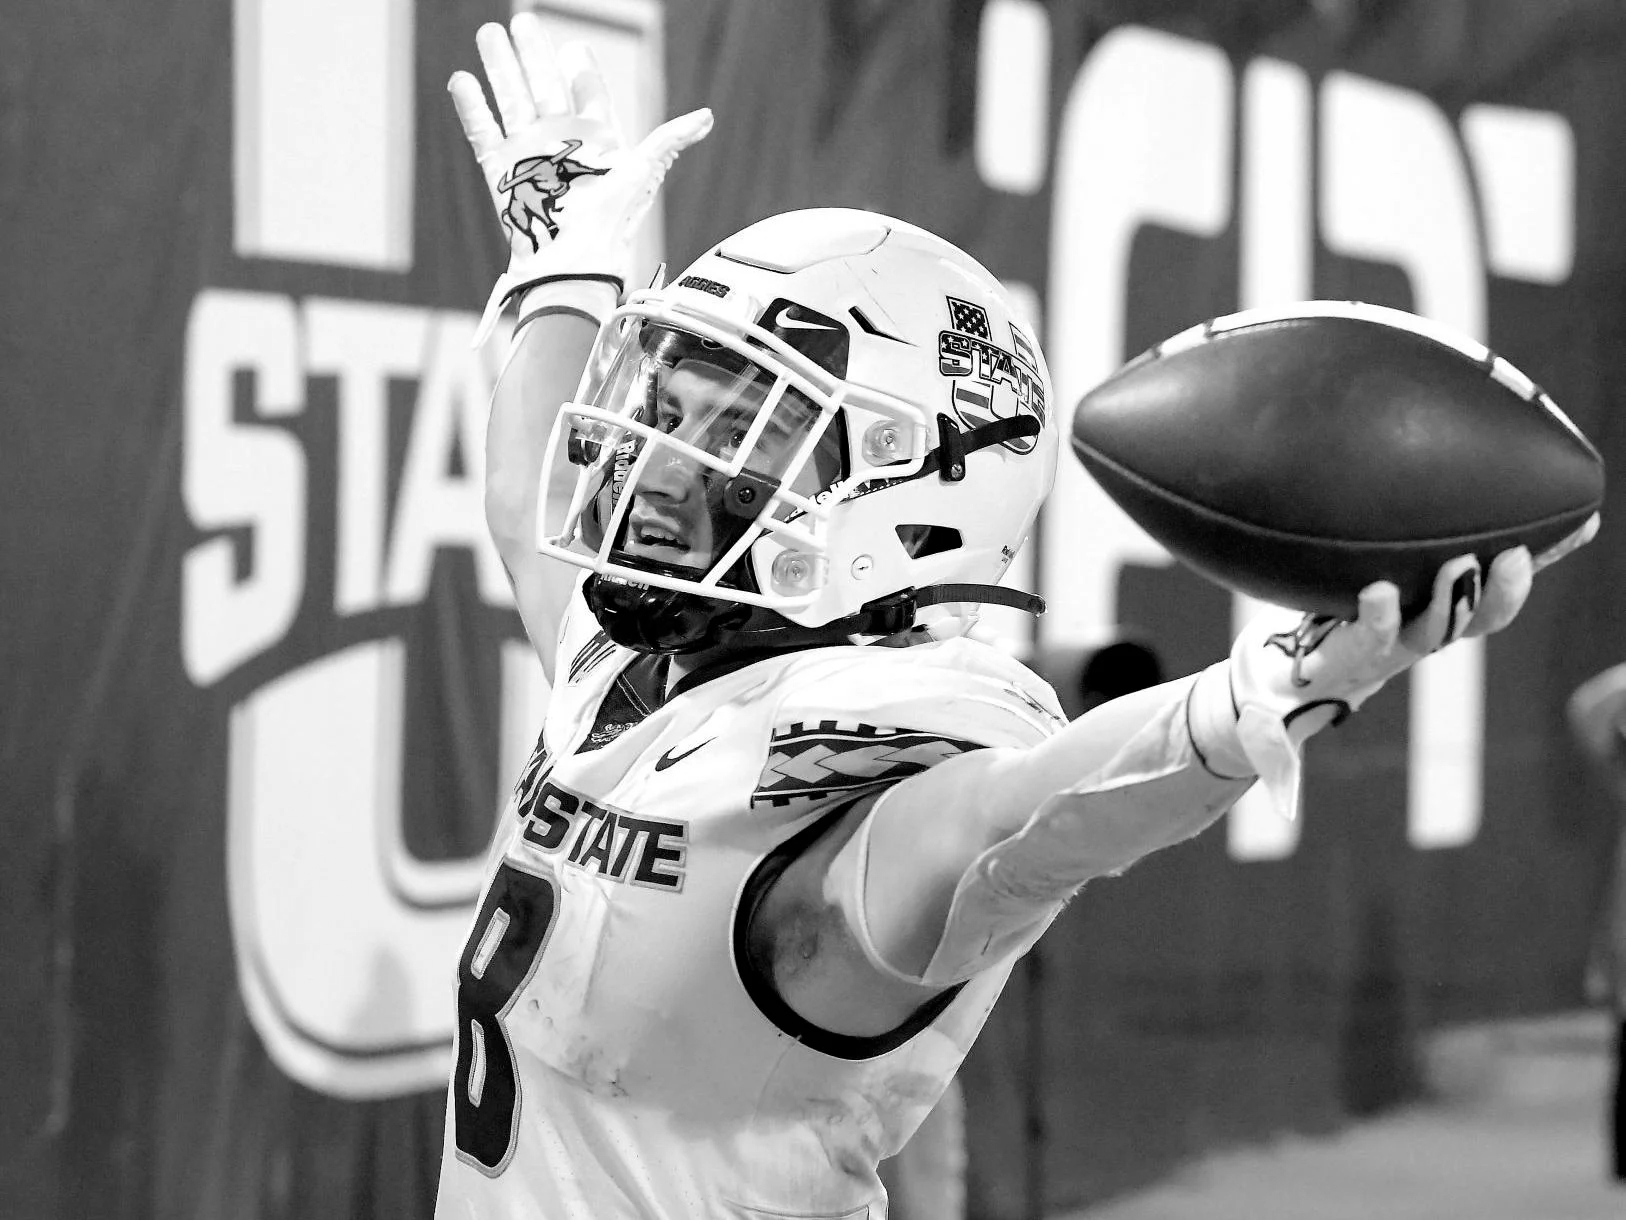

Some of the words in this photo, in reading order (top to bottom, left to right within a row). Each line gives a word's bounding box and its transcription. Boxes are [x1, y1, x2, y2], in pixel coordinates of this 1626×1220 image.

[678, 275, 731, 299] AGGIES
[938, 330, 1046, 429] STATE
[521, 779, 690, 894] STATE
[453, 857, 563, 1179] 8
